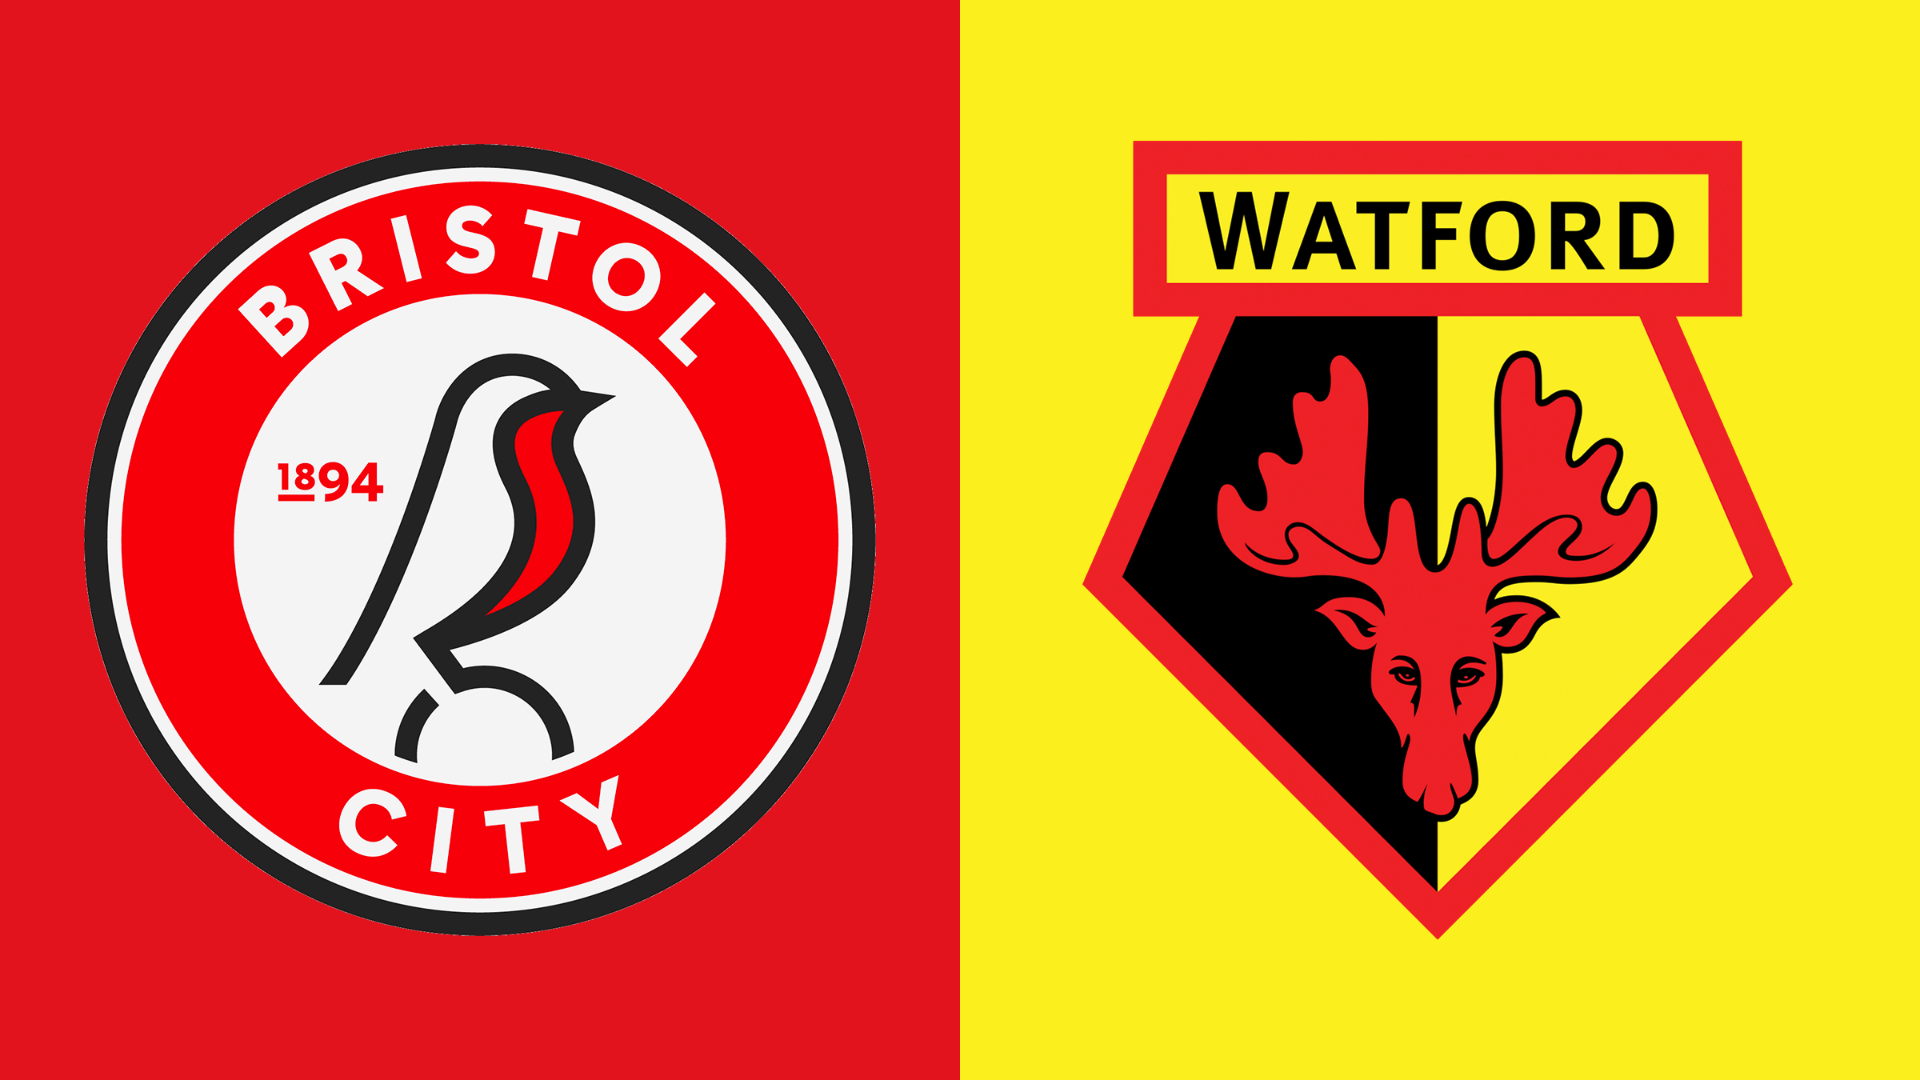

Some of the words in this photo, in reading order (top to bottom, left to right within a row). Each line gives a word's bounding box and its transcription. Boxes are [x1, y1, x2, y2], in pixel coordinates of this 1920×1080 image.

[1199, 191, 1676, 271] WATFORD
[238, 205, 716, 367] BRISTOL
[278, 461, 384, 502] 1894
[339, 775, 622, 875] CITY
